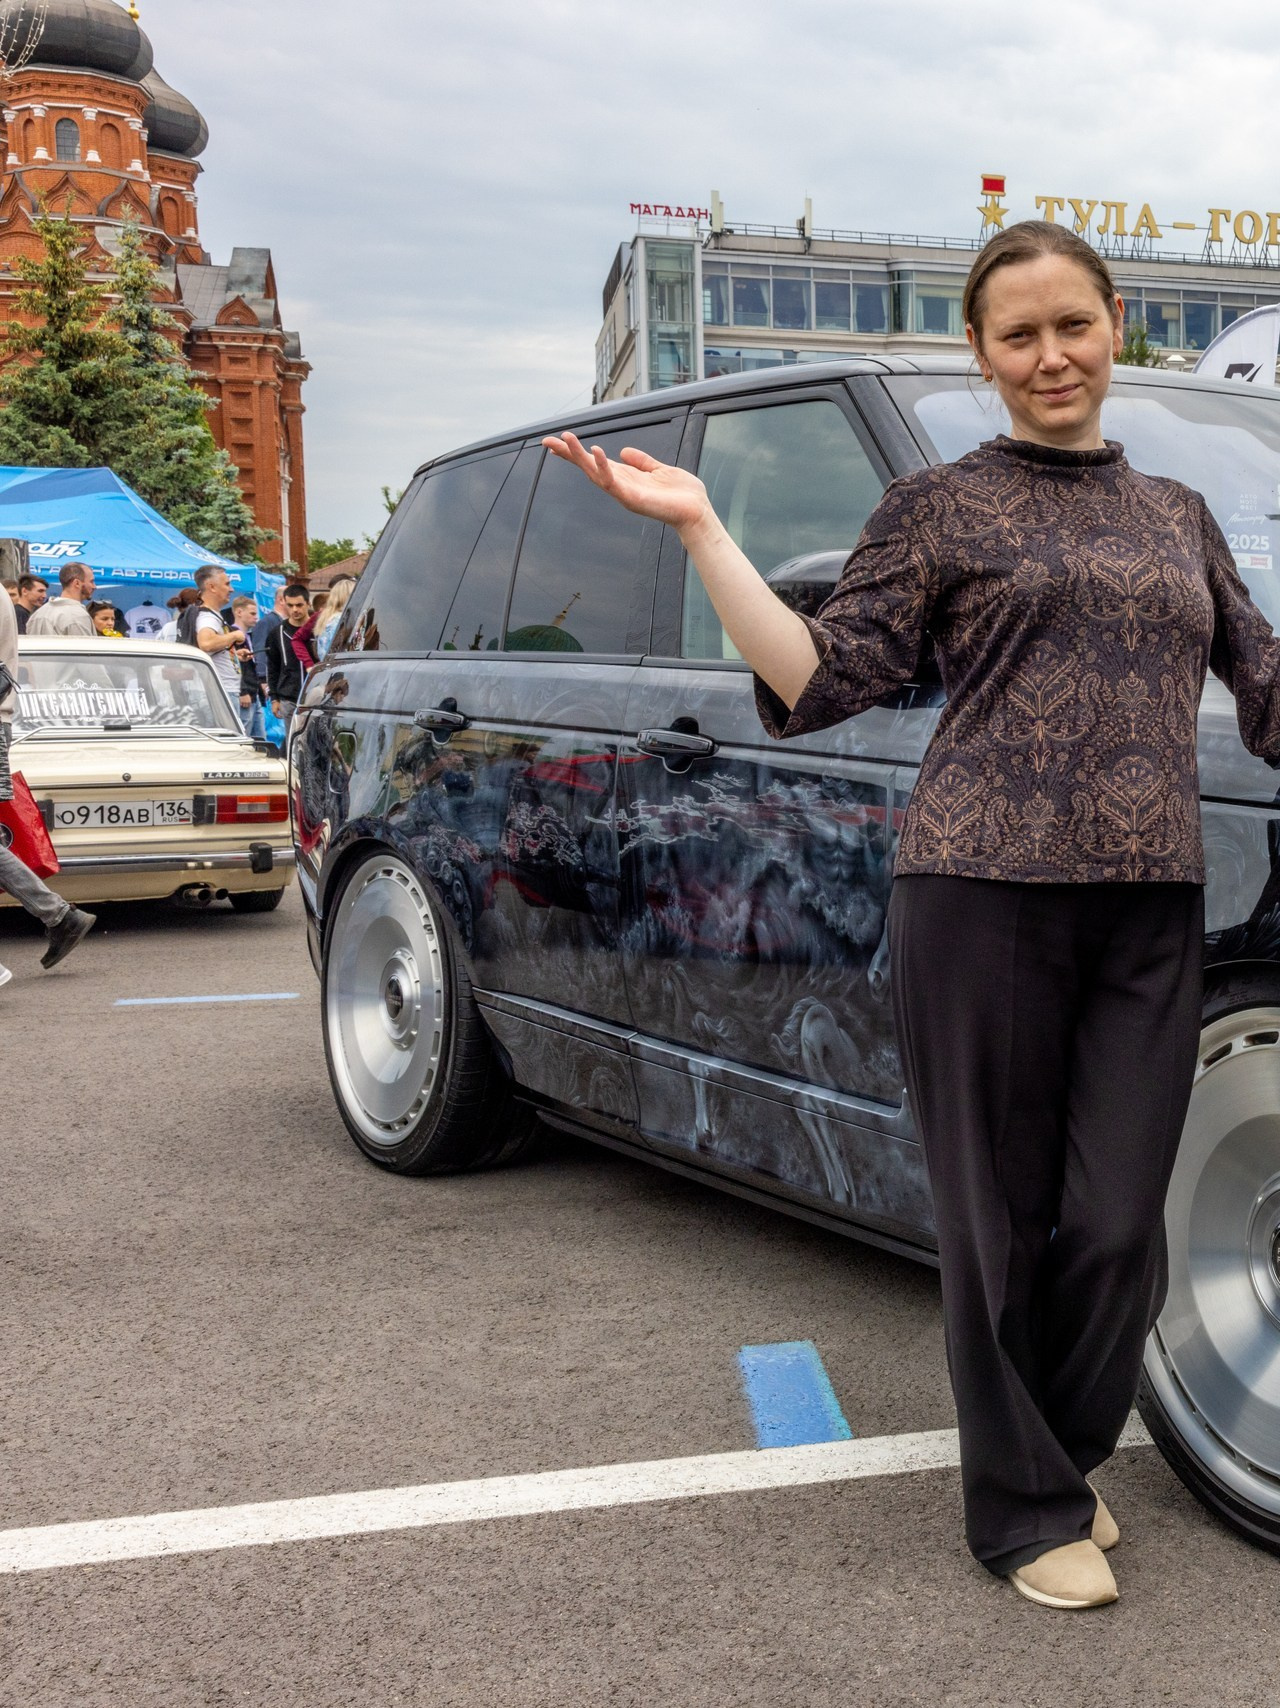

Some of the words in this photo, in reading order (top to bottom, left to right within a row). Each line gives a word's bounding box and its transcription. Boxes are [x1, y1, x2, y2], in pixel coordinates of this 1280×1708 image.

[630, 203, 708, 219] МАГАДАН
[1035, 195, 1163, 238] ТУЛА
[1228, 534, 1270, 551] 2025
[29, 565, 105, 576] АГАН
[112, 569, 242, 582] АВТОФАА
[60, 805, 150, 825] О918АВ
[156, 802, 187, 817] 136
